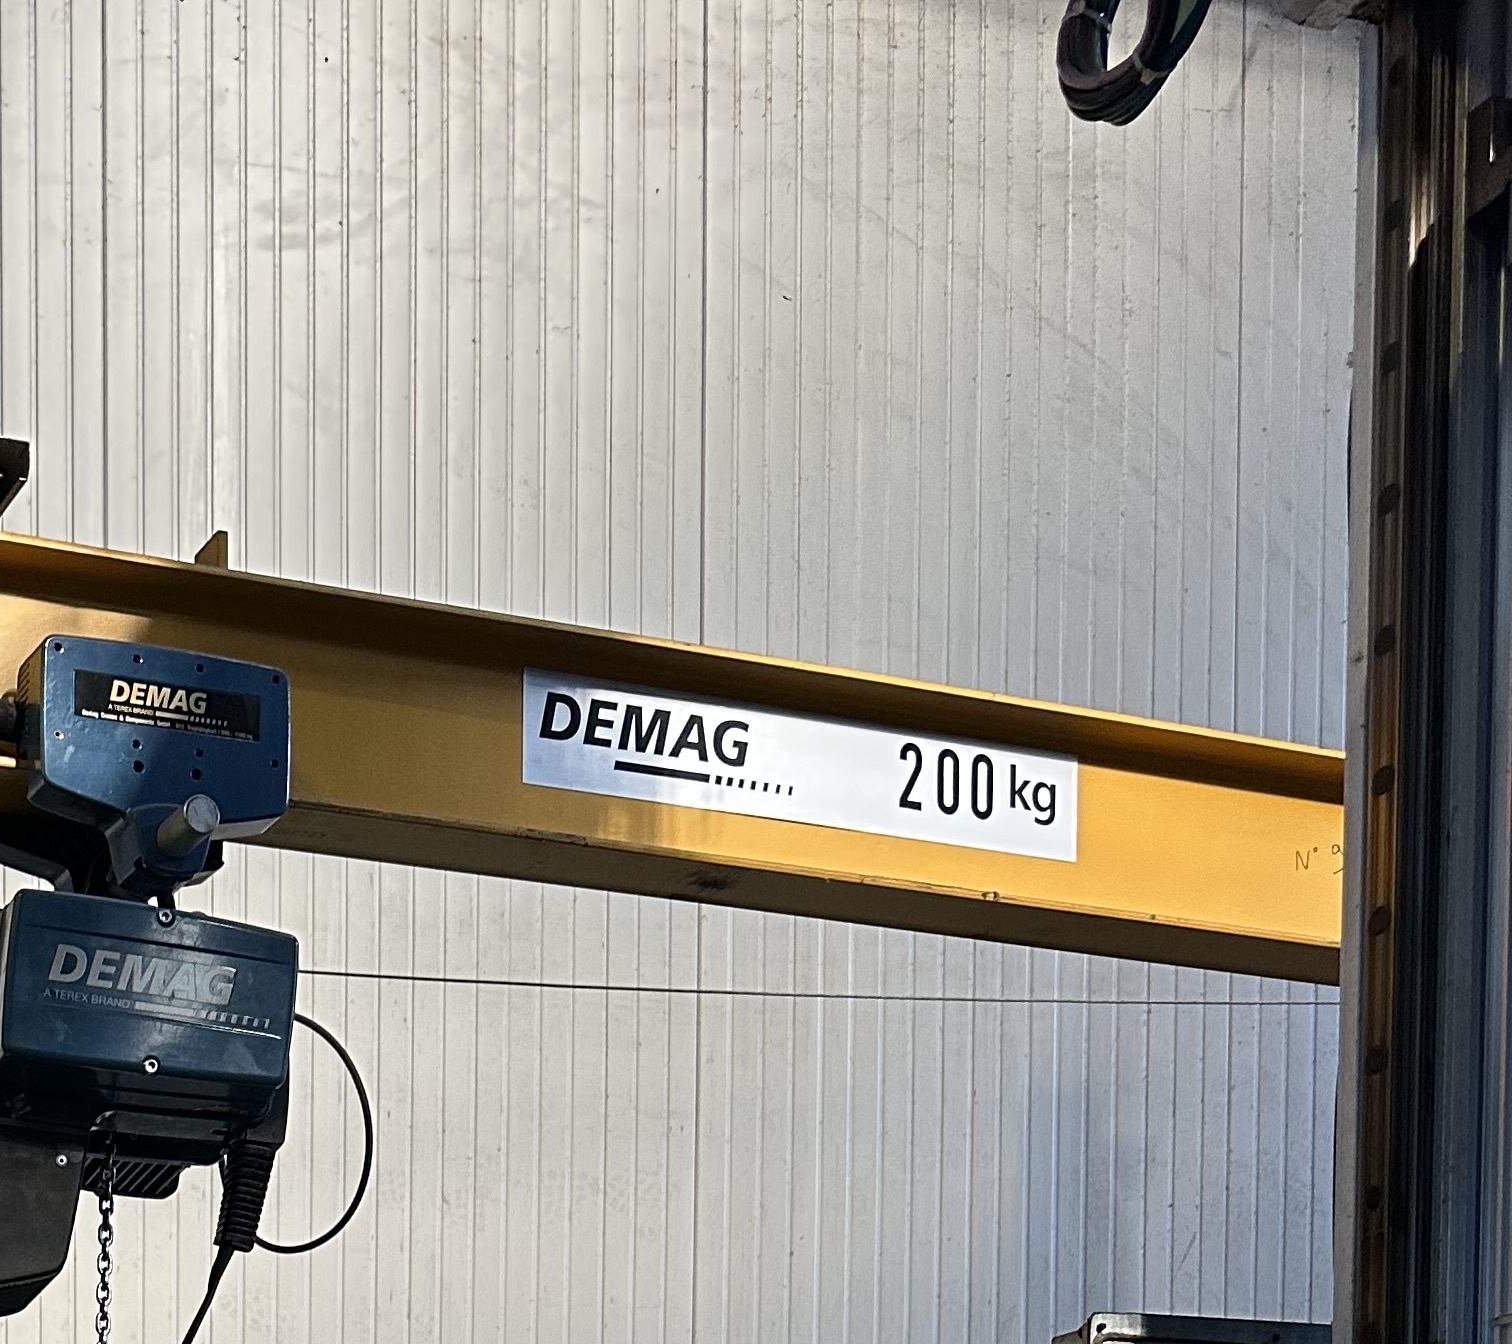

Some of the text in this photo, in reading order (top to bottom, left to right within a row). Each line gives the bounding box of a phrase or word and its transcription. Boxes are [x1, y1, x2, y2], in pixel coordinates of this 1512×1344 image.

[109, 679, 207, 714] DEMAG
[113, 704, 133, 713] TEREX
[539, 690, 751, 769] DEMAG
[897, 743, 1059, 826] 200 kg
[43, 987, 131, 1009] A TEREX BRAND
[48, 943, 237, 1006] DEMAG
